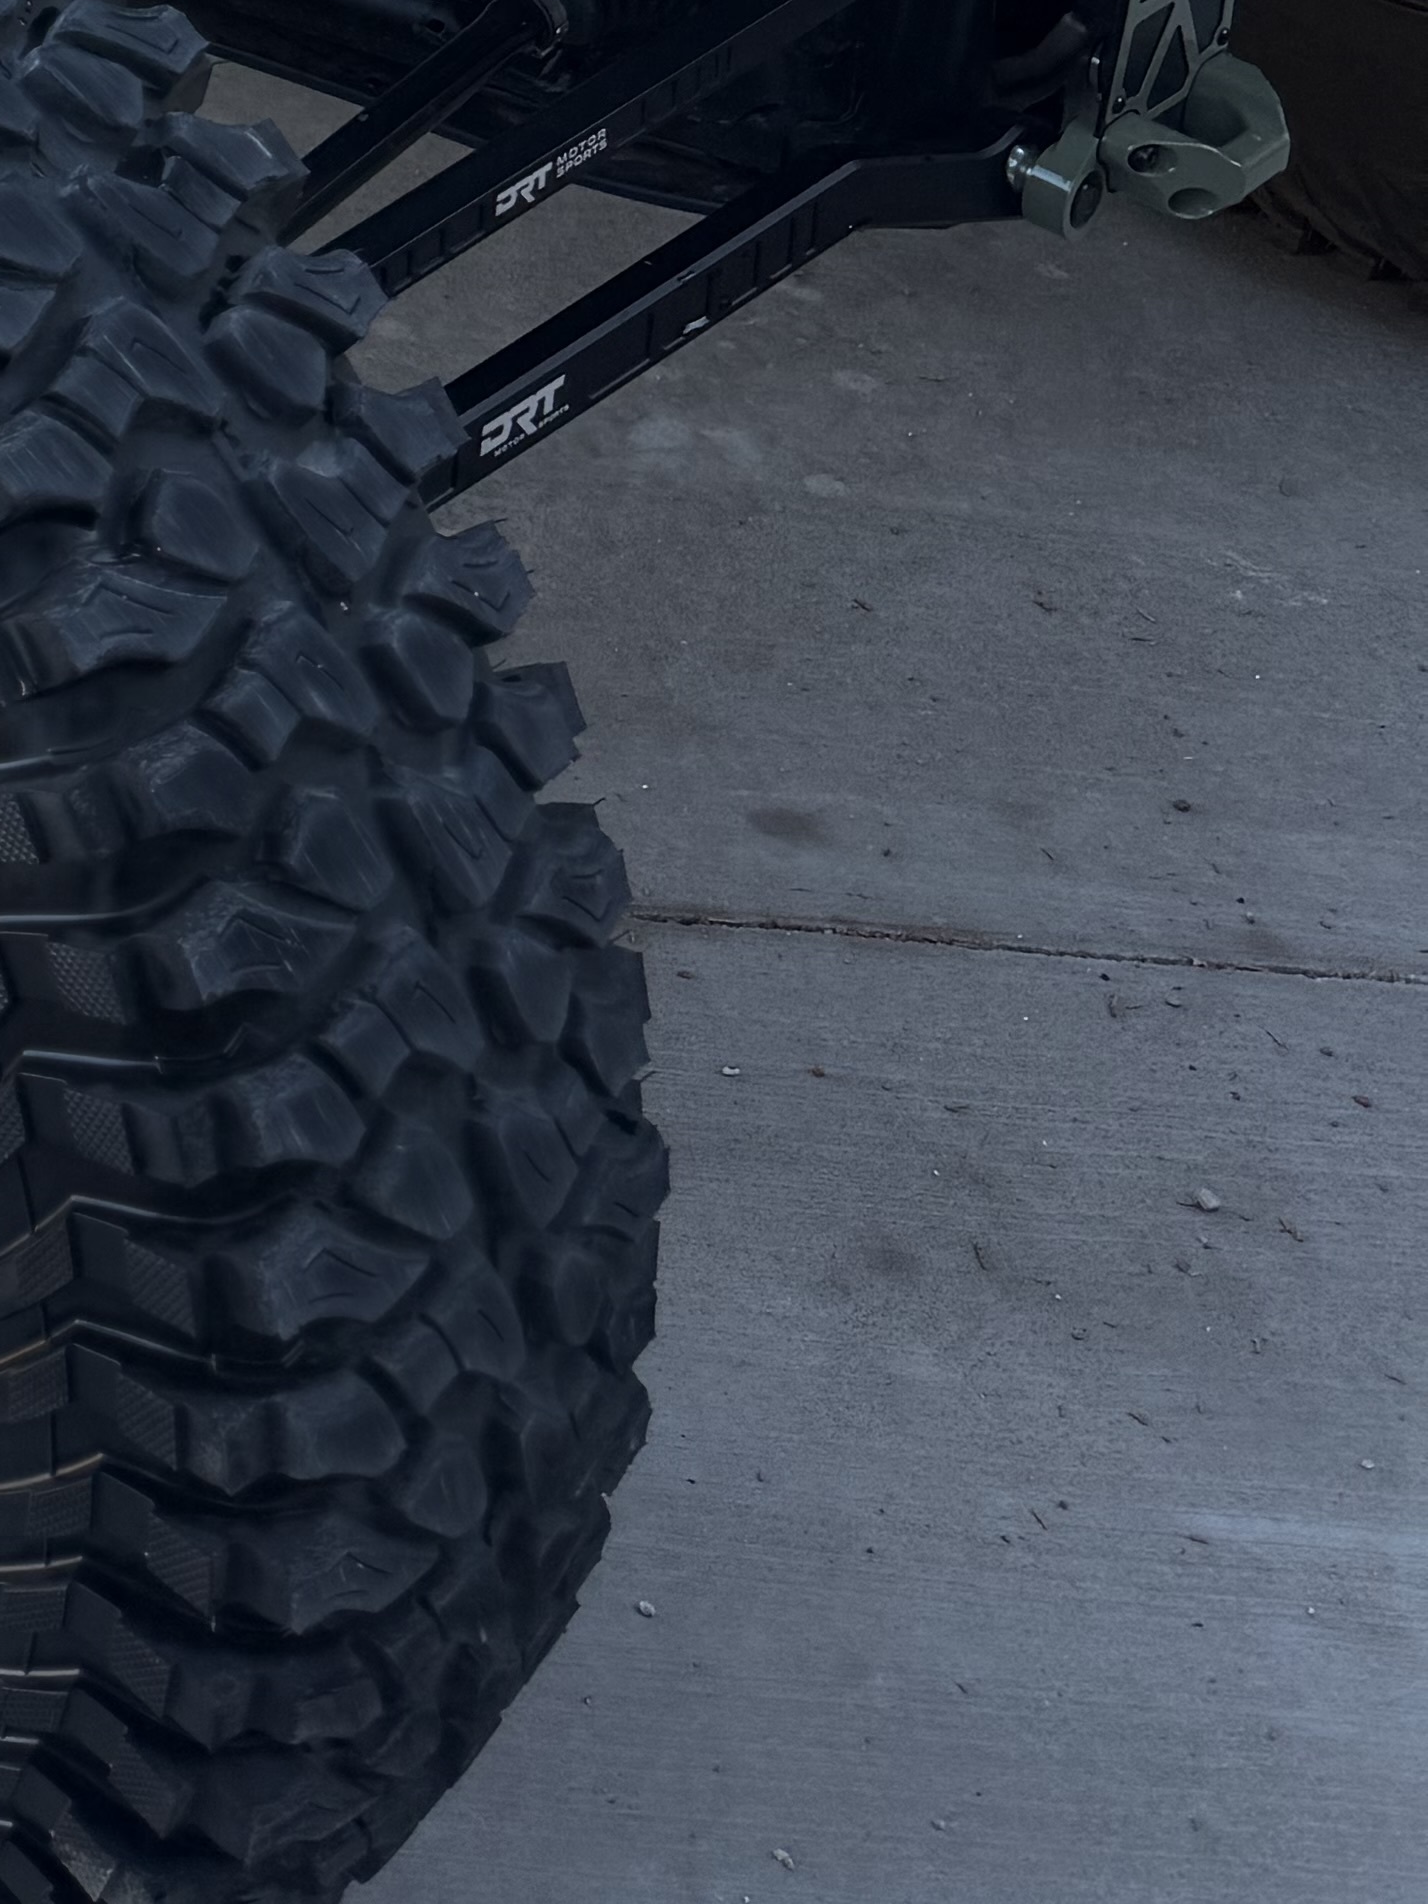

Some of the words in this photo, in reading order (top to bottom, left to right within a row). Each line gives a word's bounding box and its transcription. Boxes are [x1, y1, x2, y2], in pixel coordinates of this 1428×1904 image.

[556, 128, 607, 167] MOTOR
[556, 138, 608, 179] SPORTS
[495, 161, 553, 217] DRT
[479, 374, 566, 457] DRT
